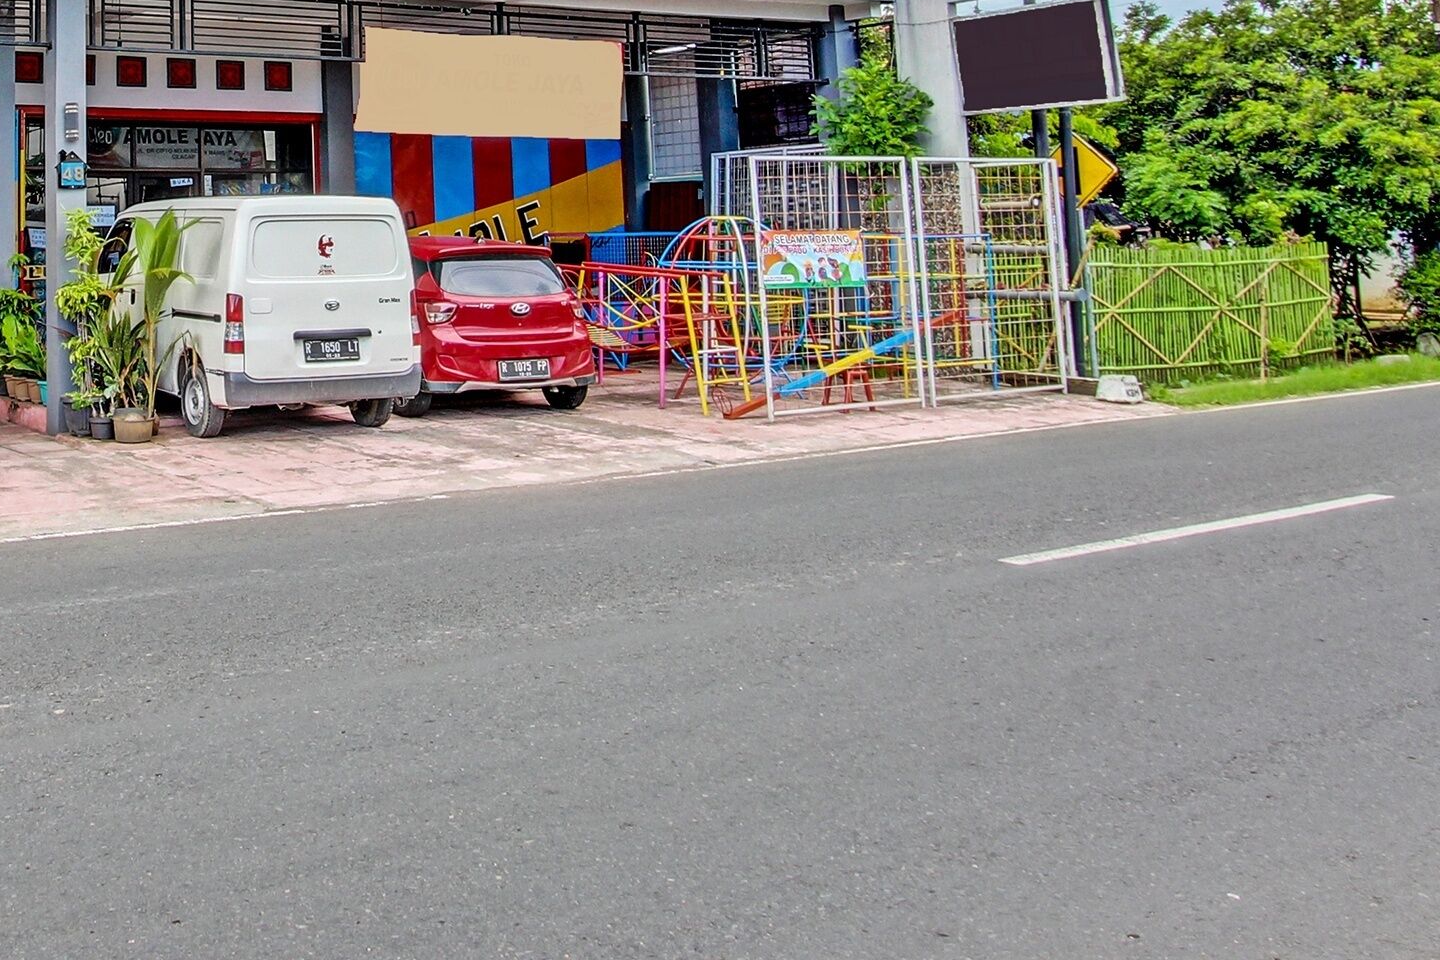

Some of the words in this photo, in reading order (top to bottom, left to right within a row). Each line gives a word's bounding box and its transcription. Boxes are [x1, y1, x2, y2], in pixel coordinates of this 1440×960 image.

[195, 131, 237, 147] AYA
[63, 166, 83, 182] 48
[172, 177, 192, 186] BUKA
[774, 235, 814, 244] SELAMAT
[814, 235, 850, 244] DATANG
[305, 342, 312, 354] R
[320, 341, 341, 353] 1650
[347, 340, 359, 352] LT
[501, 362, 508, 373] R
[513, 361, 532, 372] 1075
[537, 360, 547, 371] FP
